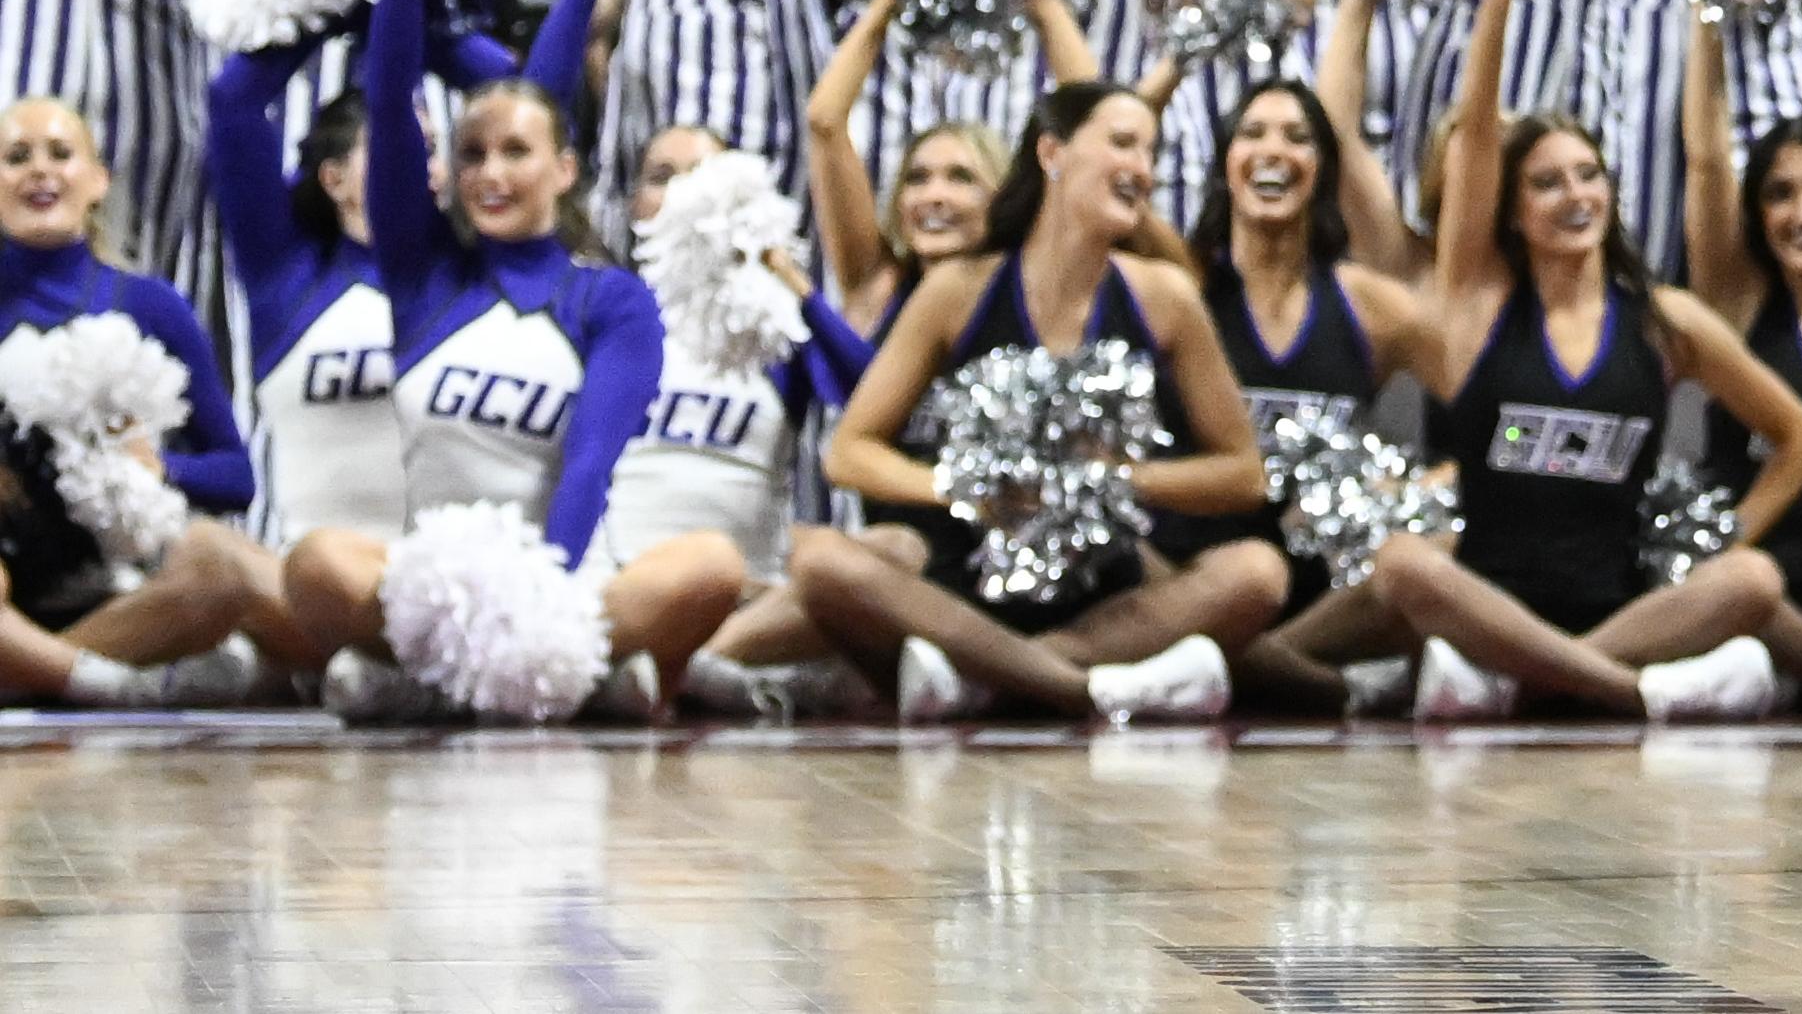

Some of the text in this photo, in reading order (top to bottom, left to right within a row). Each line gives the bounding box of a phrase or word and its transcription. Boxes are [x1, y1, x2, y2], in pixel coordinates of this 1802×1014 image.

[304, 347, 397, 404] GC
[427, 365, 576, 441] GCU
[647, 390, 758, 448] CU
